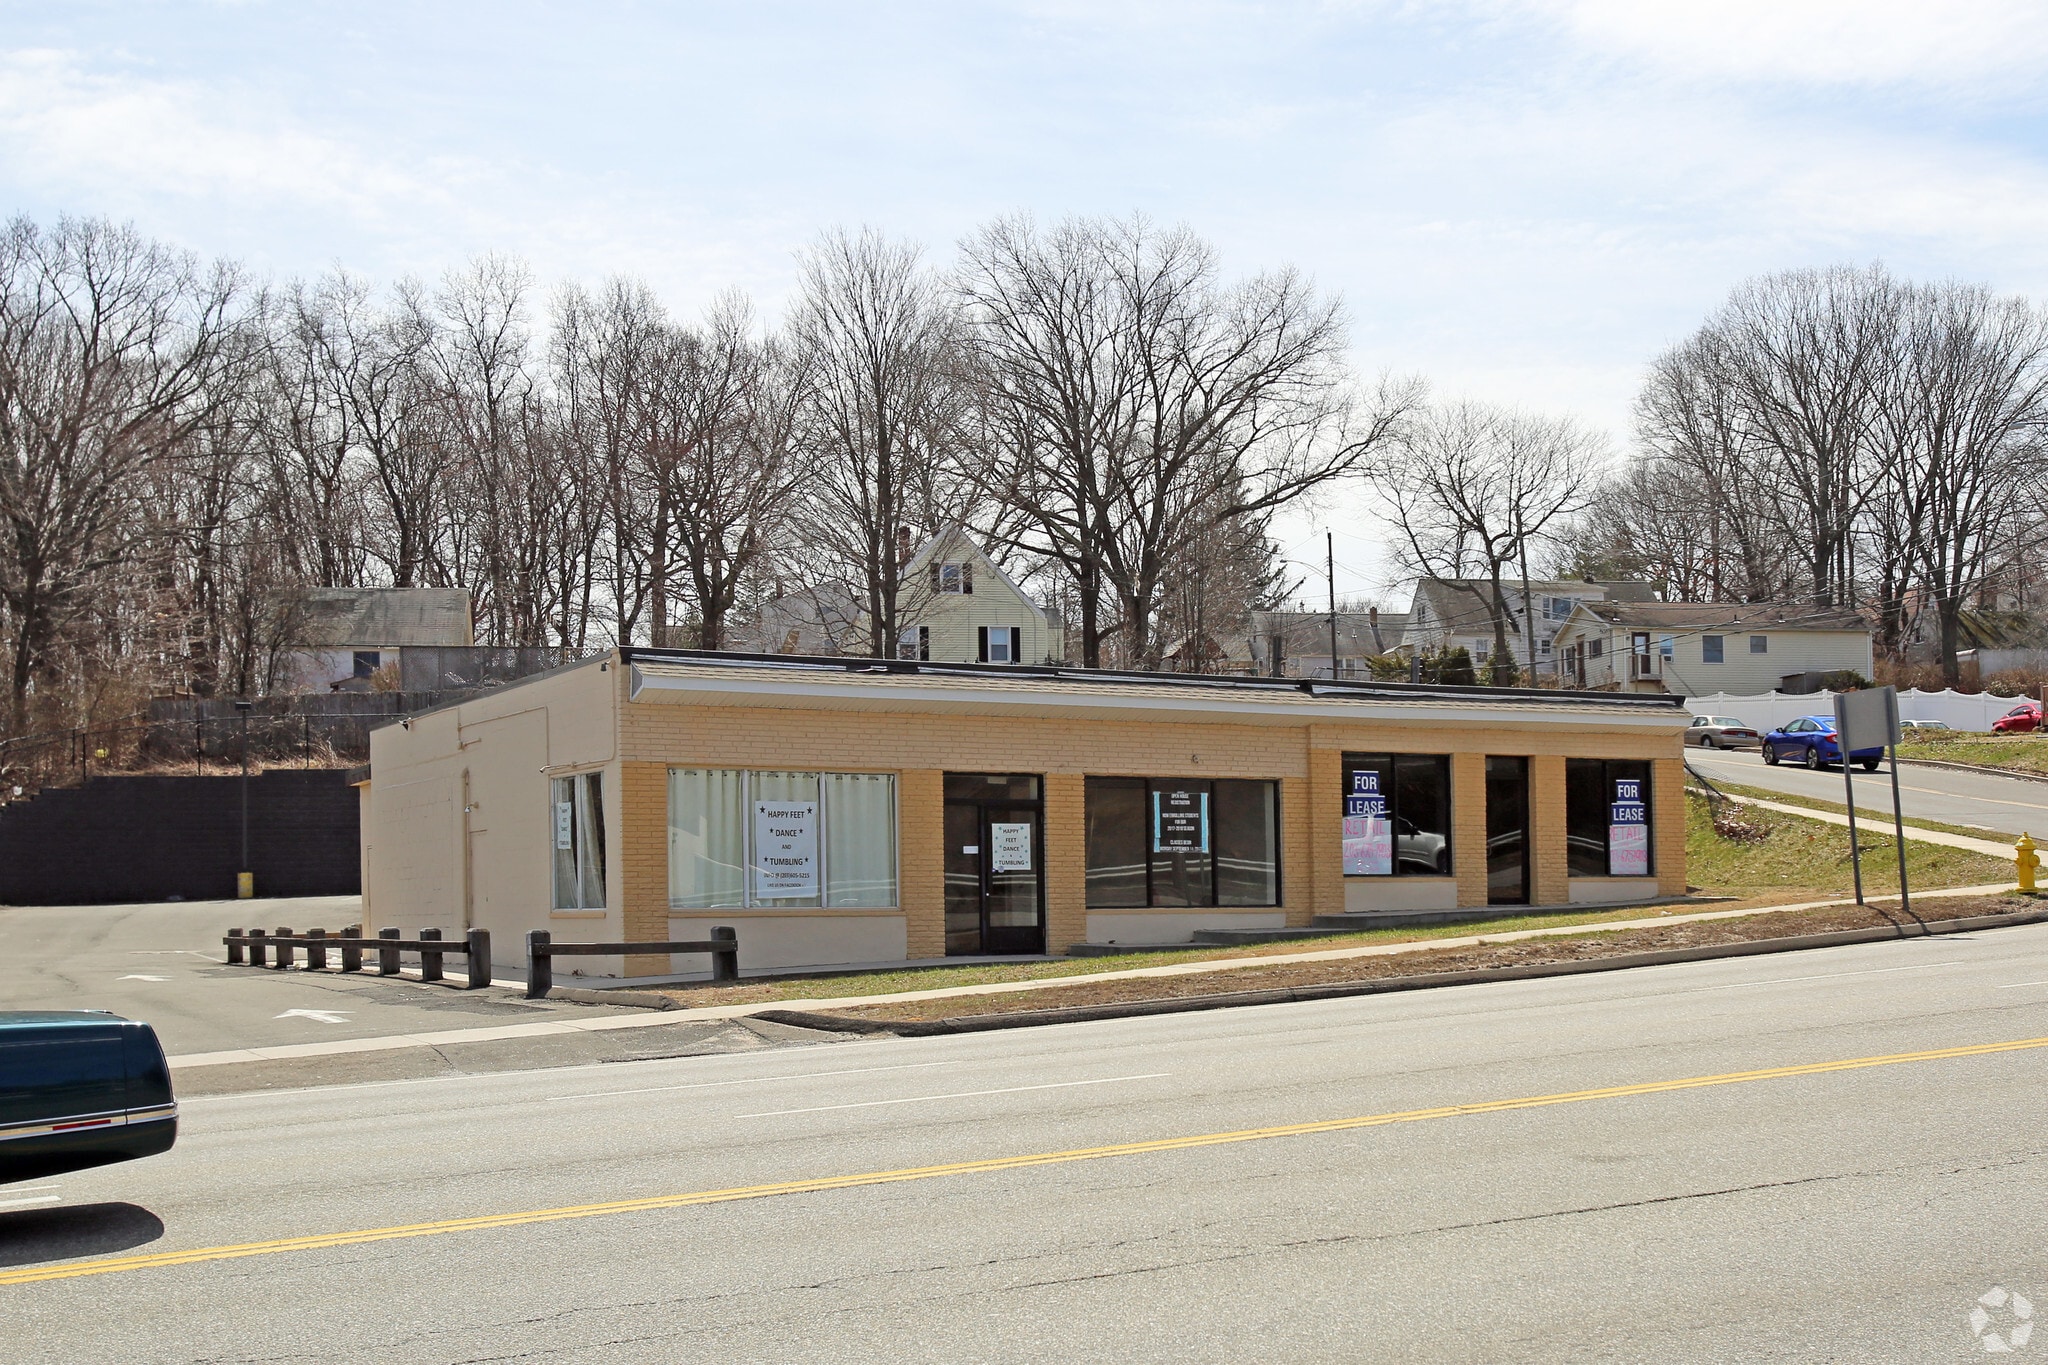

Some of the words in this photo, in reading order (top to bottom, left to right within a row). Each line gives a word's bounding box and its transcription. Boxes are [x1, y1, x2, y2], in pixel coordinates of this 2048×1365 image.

[1354, 776, 1378, 790] FOR
[1617, 785, 1638, 798] FOR
[1349, 801, 1385, 814] LEASE
[1613, 808, 1644, 821] LEASE
[769, 858, 803, 866] TUMBLING
